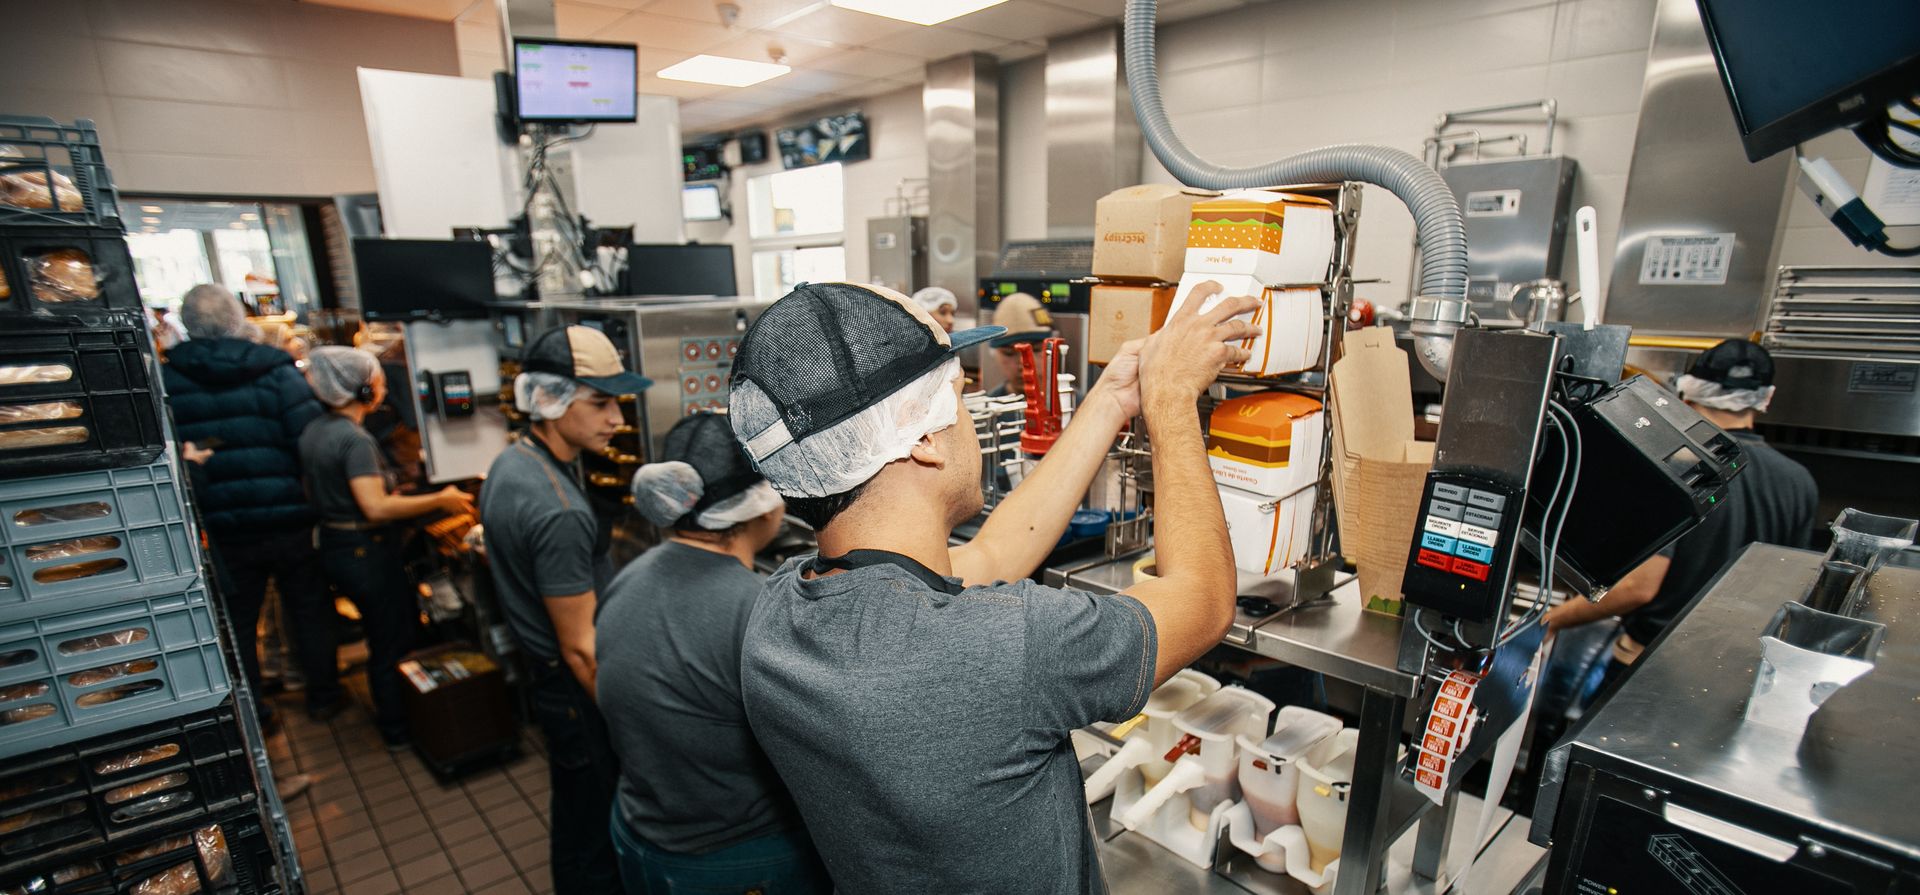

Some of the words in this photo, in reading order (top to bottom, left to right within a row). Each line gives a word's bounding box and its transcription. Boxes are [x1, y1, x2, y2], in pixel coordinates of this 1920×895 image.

[1437, 487, 1458, 496] SERVIDO
[1473, 494, 1495, 504] SERVIDO
[1427, 535, 1446, 544] LLAMAR
[1427, 540, 1444, 548] ORDEN
[1462, 543, 1482, 553] LLAMAR
[1462, 548, 1480, 557] ORDEN
